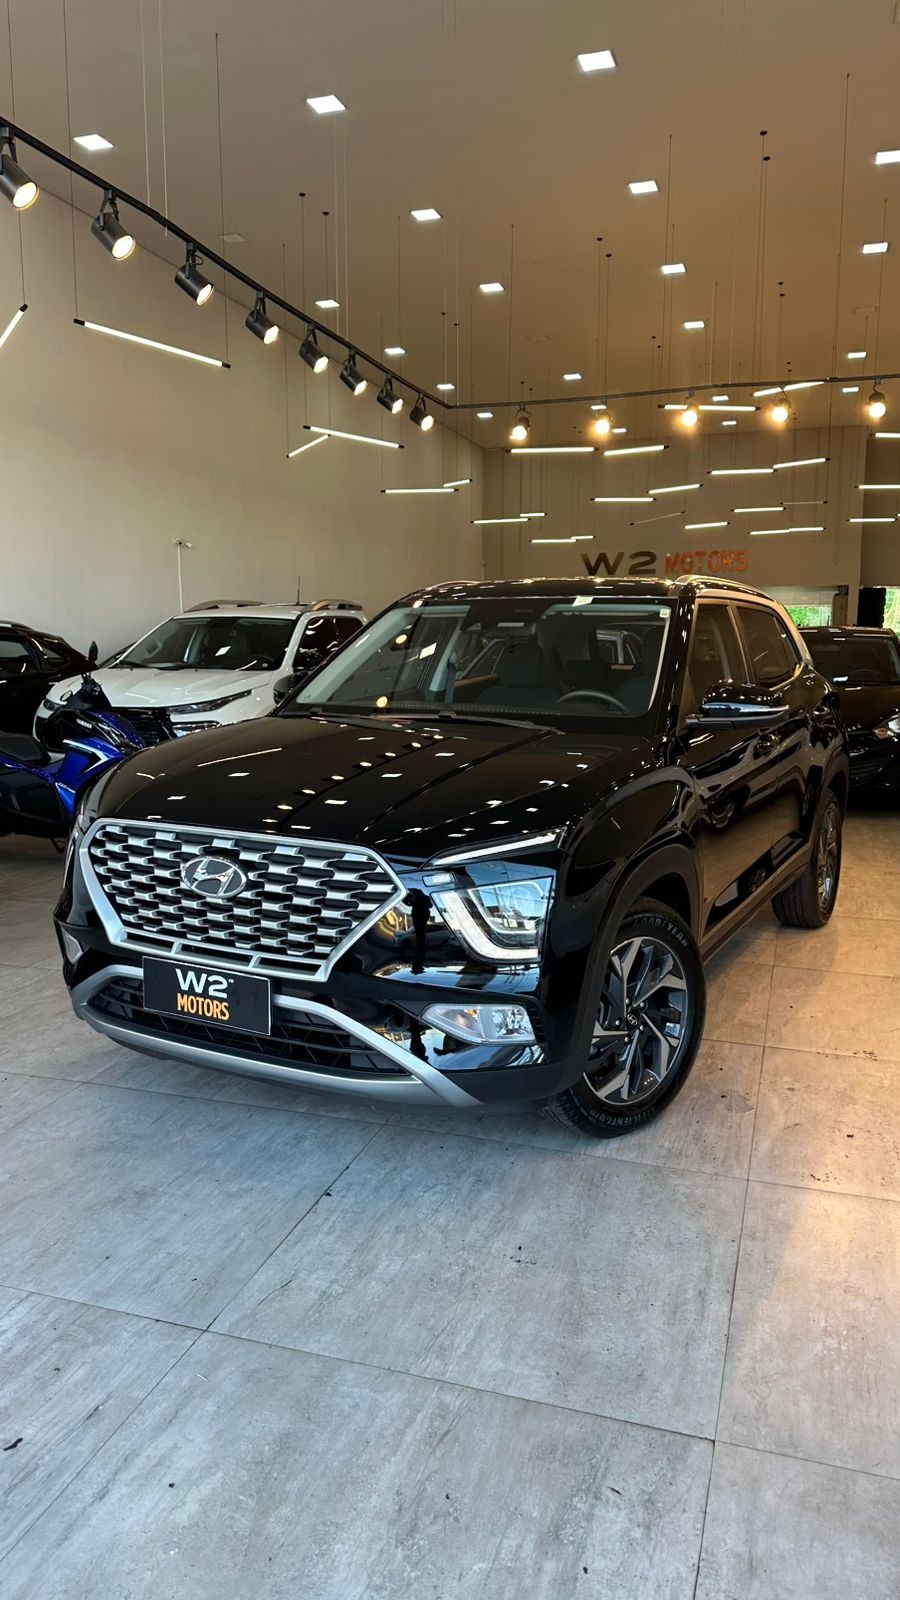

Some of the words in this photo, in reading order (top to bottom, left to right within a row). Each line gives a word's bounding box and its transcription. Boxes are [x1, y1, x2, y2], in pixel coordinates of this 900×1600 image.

[581, 551, 657, 575] W2
[665, 550, 749, 574] MOTORS
[177, 993, 230, 1020] MOTORS
